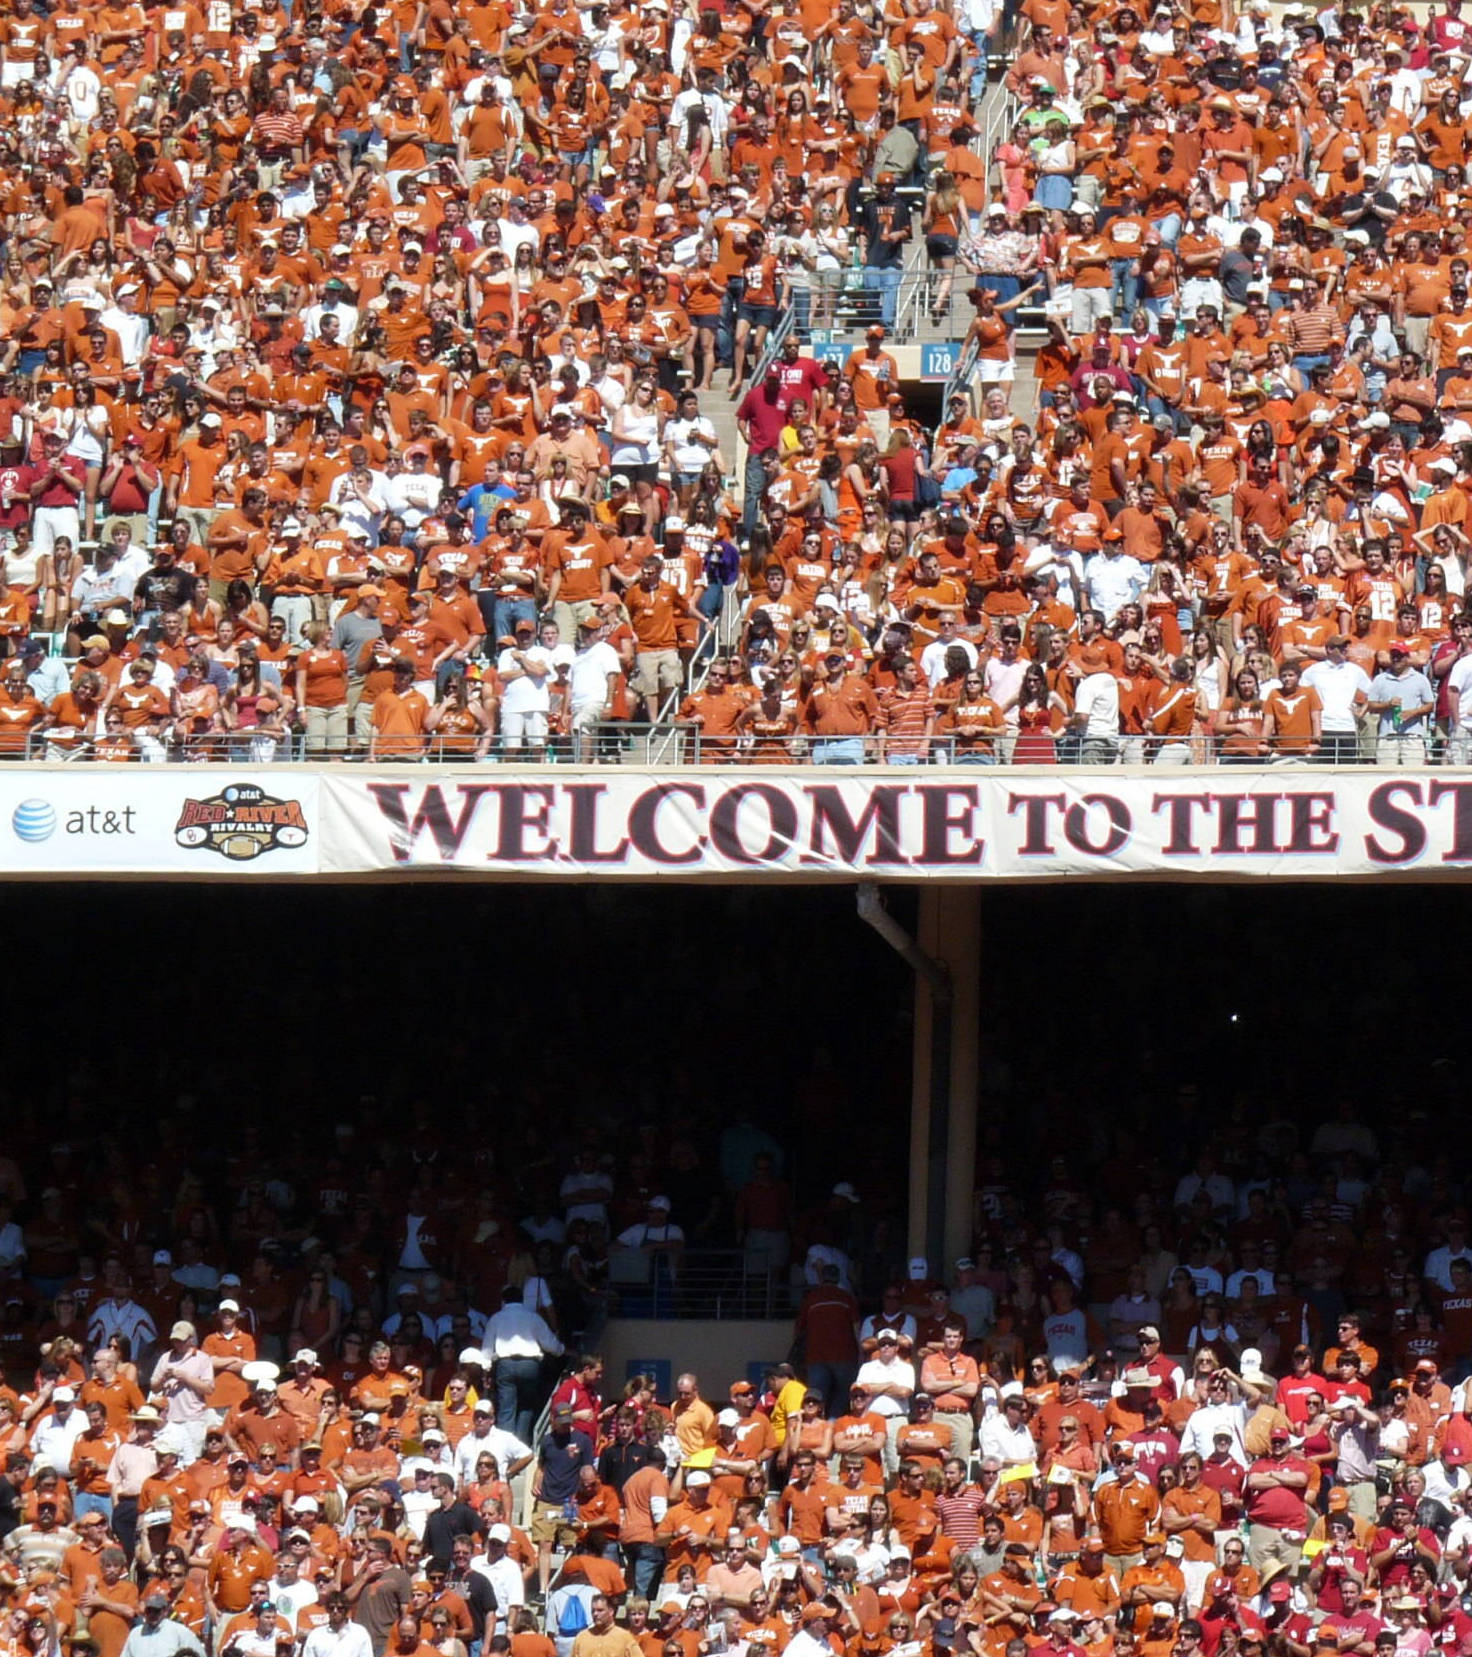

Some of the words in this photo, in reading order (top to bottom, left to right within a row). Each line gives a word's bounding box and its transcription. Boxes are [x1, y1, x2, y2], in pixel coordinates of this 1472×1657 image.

[208, 6, 232, 31] 12
[931, 107, 962, 118] TEXAS
[928, 353, 952, 373] 128
[1202, 446, 1232, 455] TEXAS
[314, 540, 343, 550] TEXAS
[438, 552, 468, 564] TEXAS
[1215, 571, 1230, 589] 7
[1369, 590, 1397, 621] 12
[1421, 606, 1442, 629] 12
[66, 805, 136, 834] at&t
[177, 799, 227, 828] RED
[234, 800, 306, 831] RIVER
[210, 822, 275, 832] RIVALRY
[366, 782, 985, 865] WELCOME
[1006, 791, 1131, 856] TO
[1151, 791, 1338, 855] THE
[1442, 1299, 1472, 1310] TEXAS
[1046, 1325, 1076, 1337] TEXAS
[1406, 1340, 1439, 1349] TEXAS
[845, 1495, 868, 1504] TEXAS
[745, 1629, 777, 1640] TEXAS
